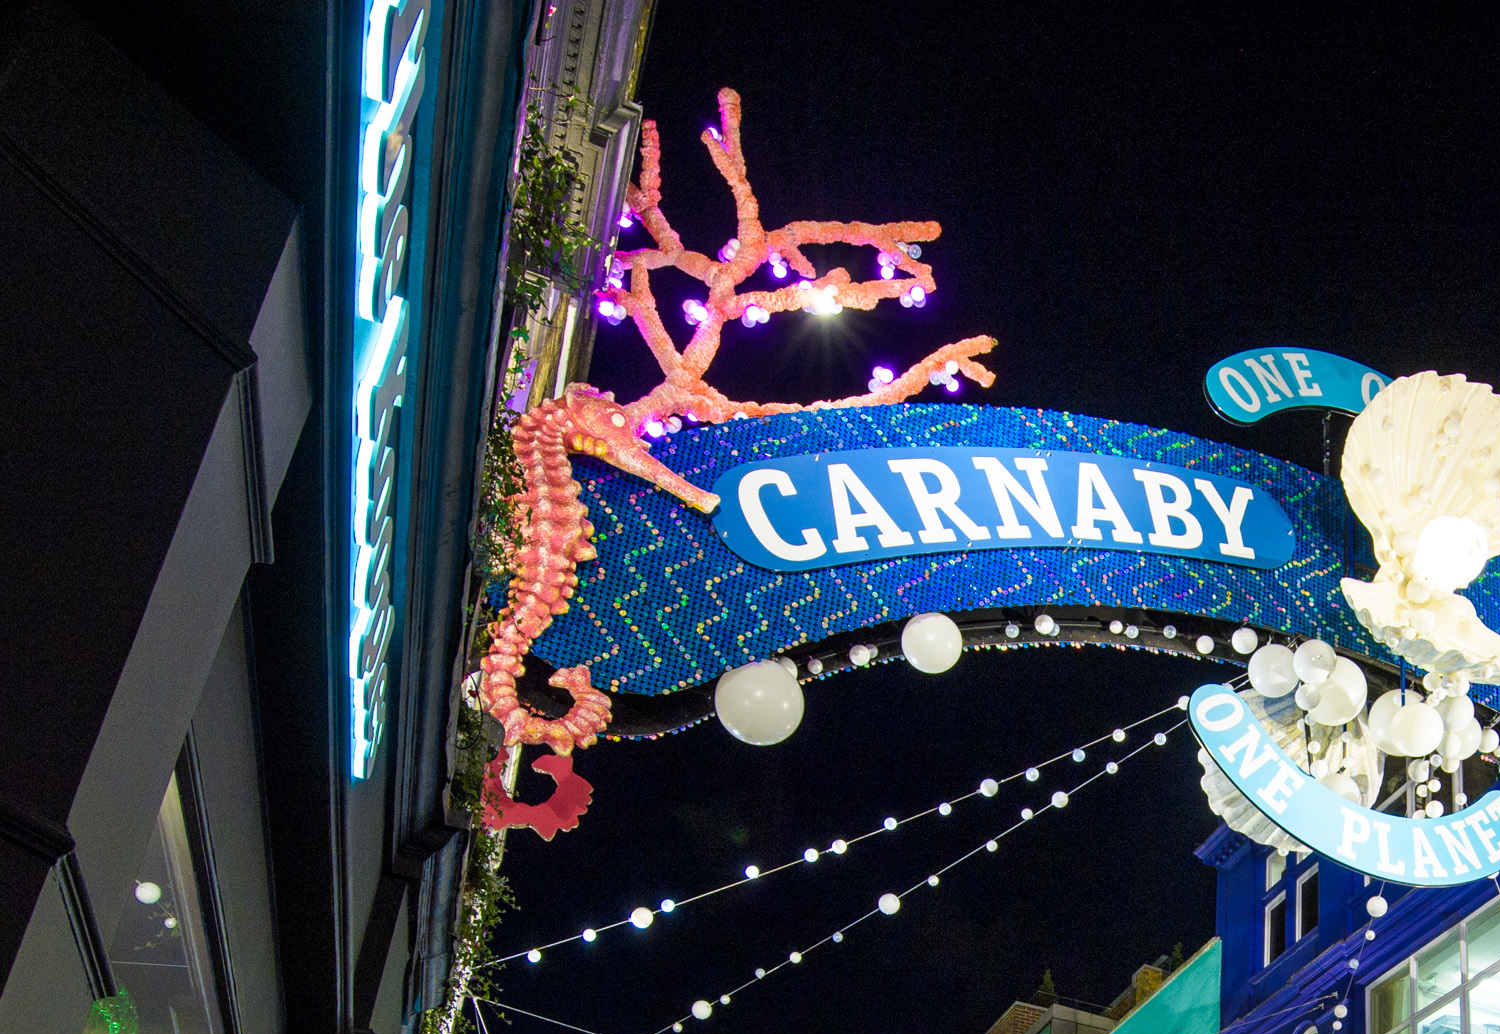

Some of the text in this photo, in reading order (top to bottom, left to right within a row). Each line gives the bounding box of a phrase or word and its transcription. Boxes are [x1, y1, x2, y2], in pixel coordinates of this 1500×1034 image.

[1218, 352, 1323, 413] ONE
[736, 456, 1259, 561] CARNABY
[1196, 693, 1305, 815] ONE
